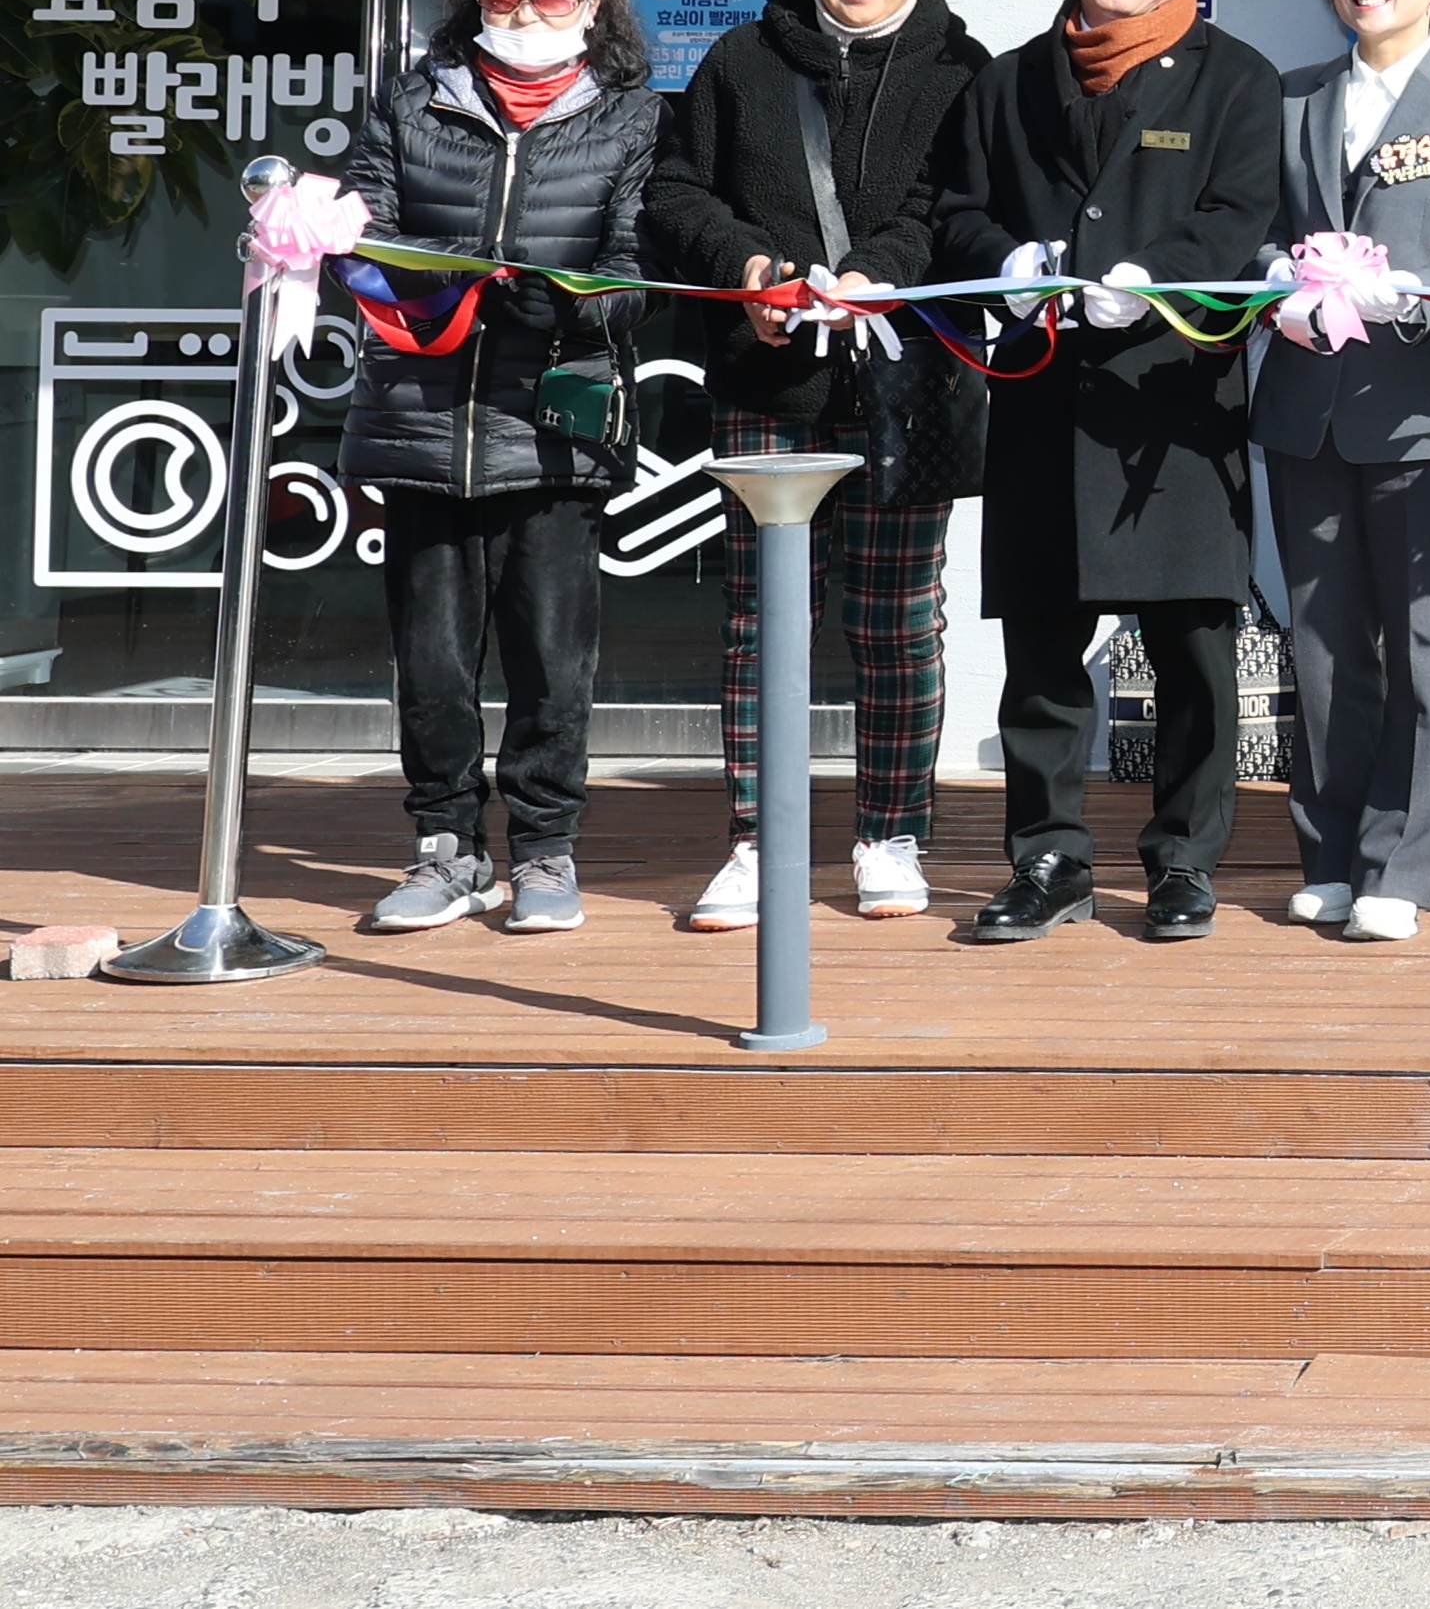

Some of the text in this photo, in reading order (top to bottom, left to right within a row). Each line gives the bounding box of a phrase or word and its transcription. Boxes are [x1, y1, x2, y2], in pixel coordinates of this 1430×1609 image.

[656, 9, 705, 26] 효심이
[687, 47, 709, 62] 이
[652, 64, 683, 79] 군민
[82, 51, 367, 157] 빨래방
